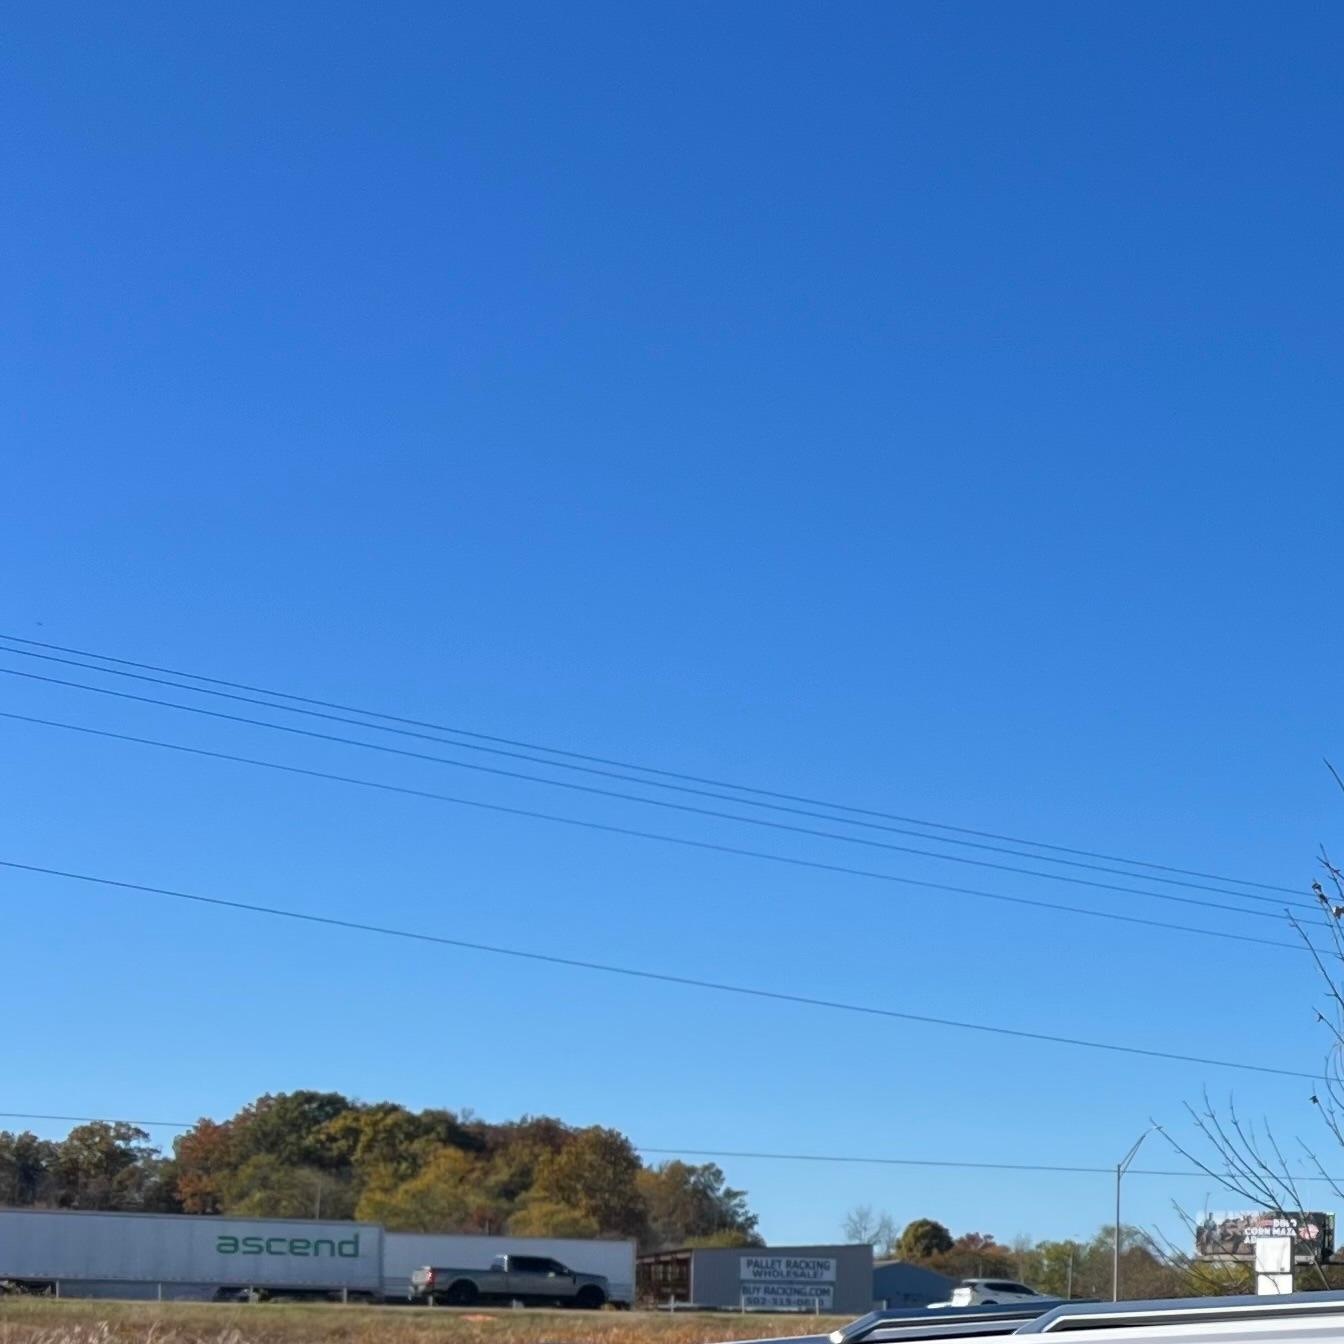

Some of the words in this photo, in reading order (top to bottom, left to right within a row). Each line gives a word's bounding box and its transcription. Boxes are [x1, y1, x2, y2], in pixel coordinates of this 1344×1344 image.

[216, 1233, 360, 1258] ascend
[746, 1259, 782, 1269] PALLET
[786, 1260, 831, 1271] RACKING
